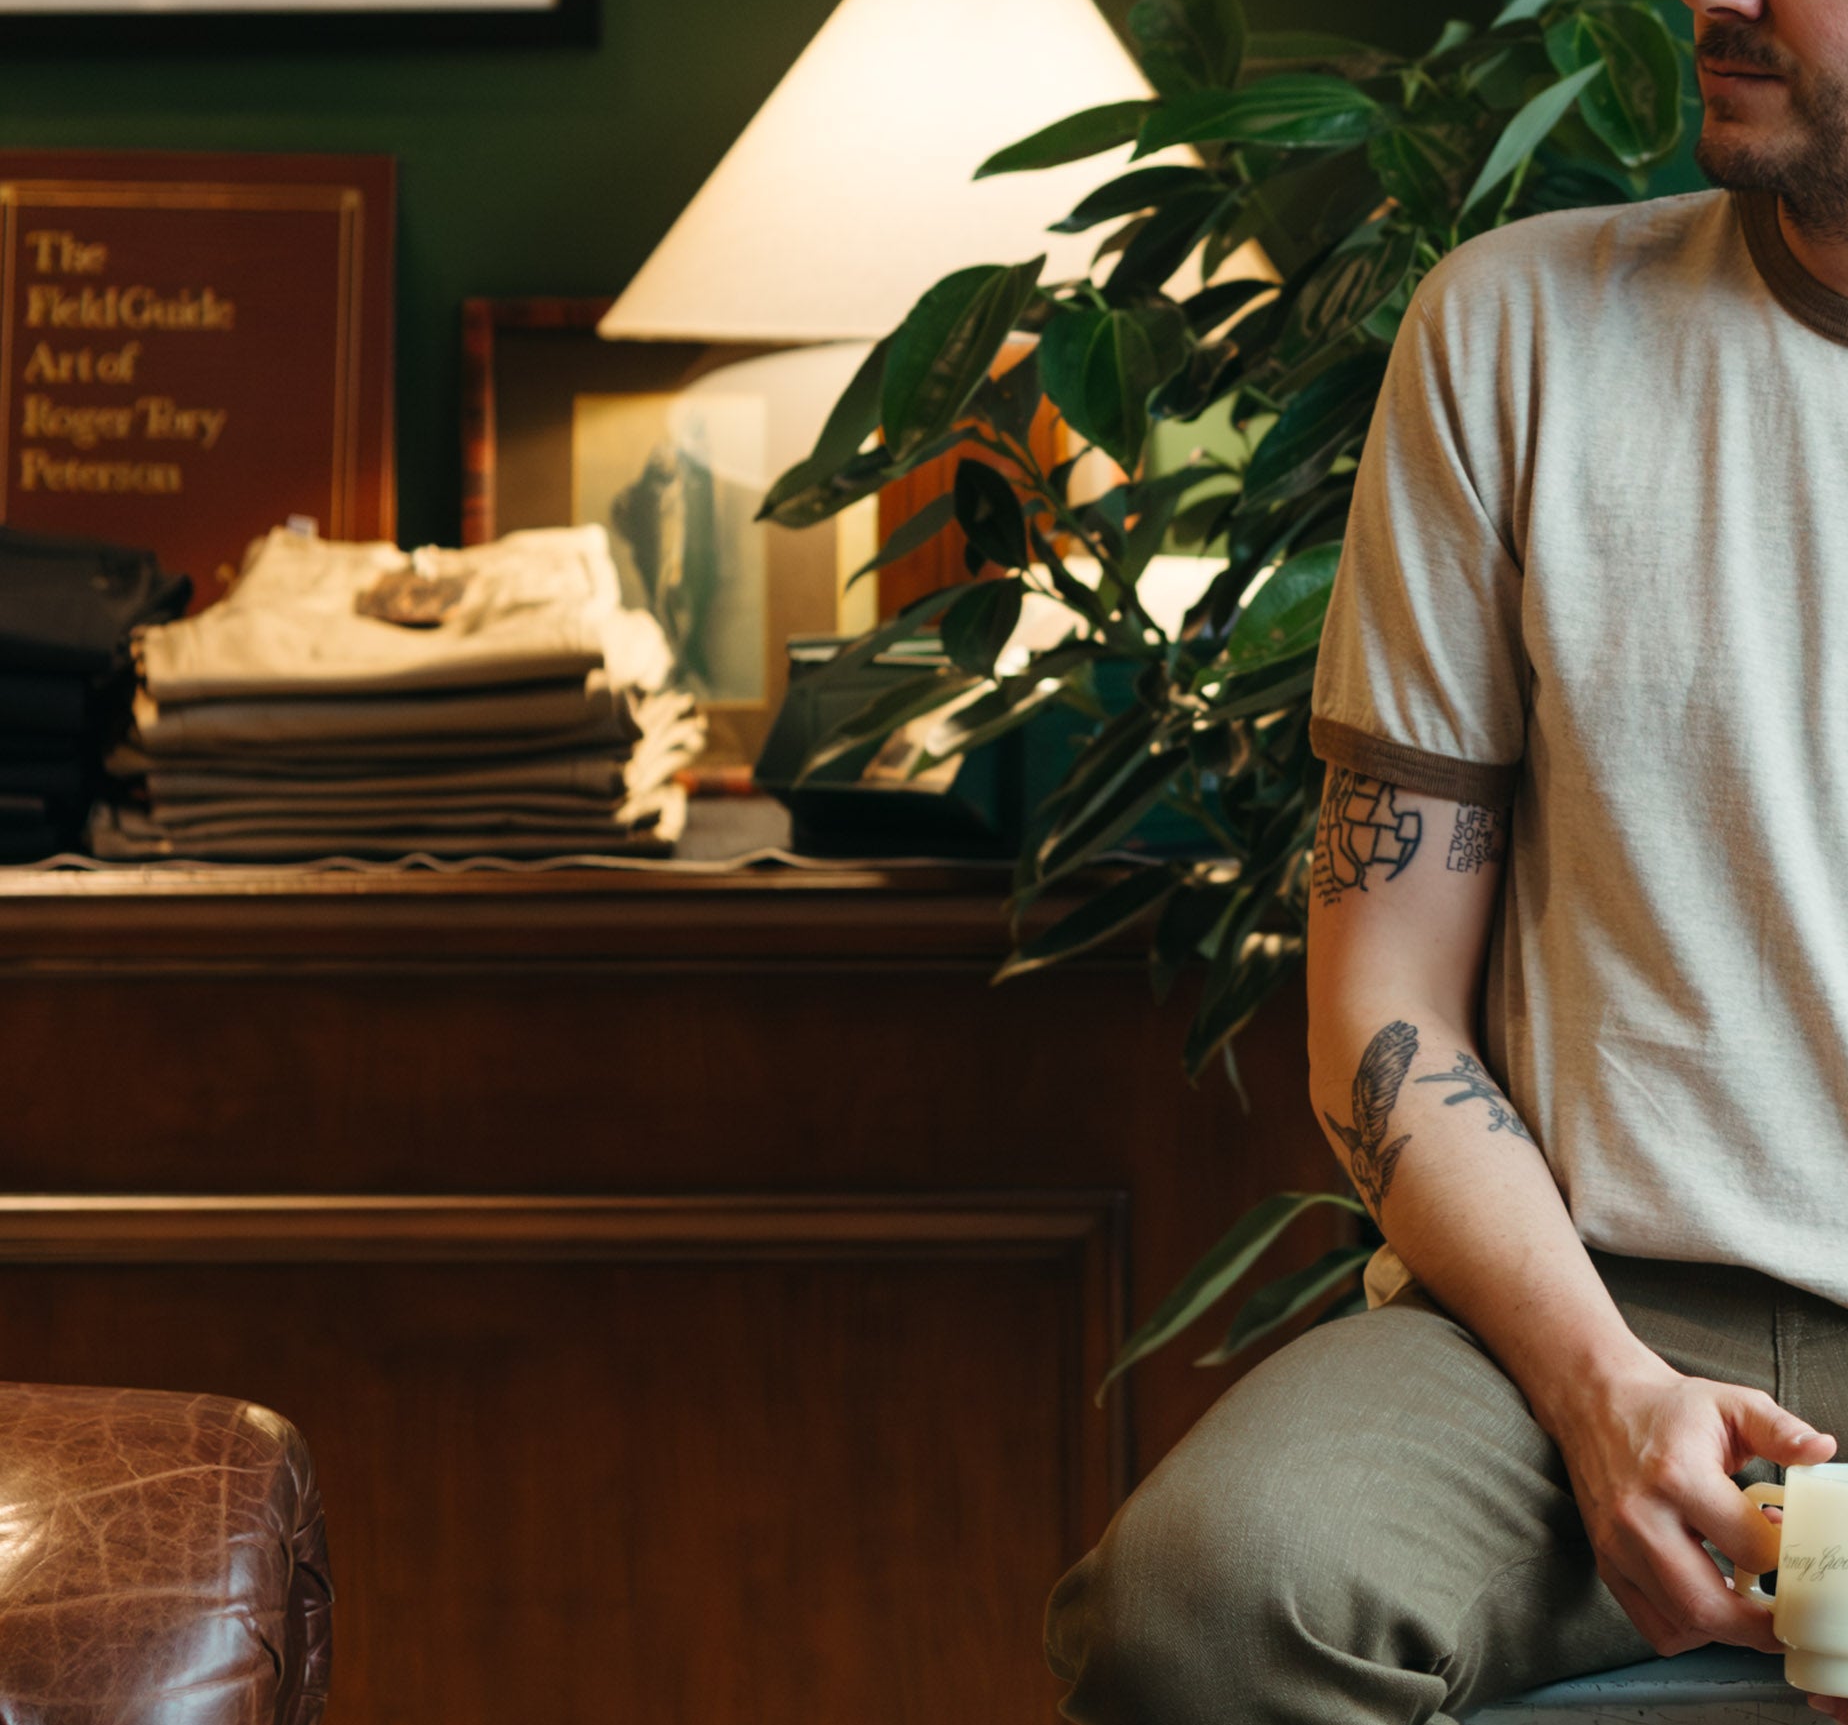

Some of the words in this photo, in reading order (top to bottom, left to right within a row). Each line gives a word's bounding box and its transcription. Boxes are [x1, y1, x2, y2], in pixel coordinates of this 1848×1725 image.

[24, 229, 108, 274] The
[23, 340, 94, 384] Art
[96, 340, 142, 385] of
[22, 393, 132, 448] Roger
[135, 395, 227, 450] Tory
[21, 450, 182, 492] Peterson
[1446, 856, 1482, 875] LEFT
